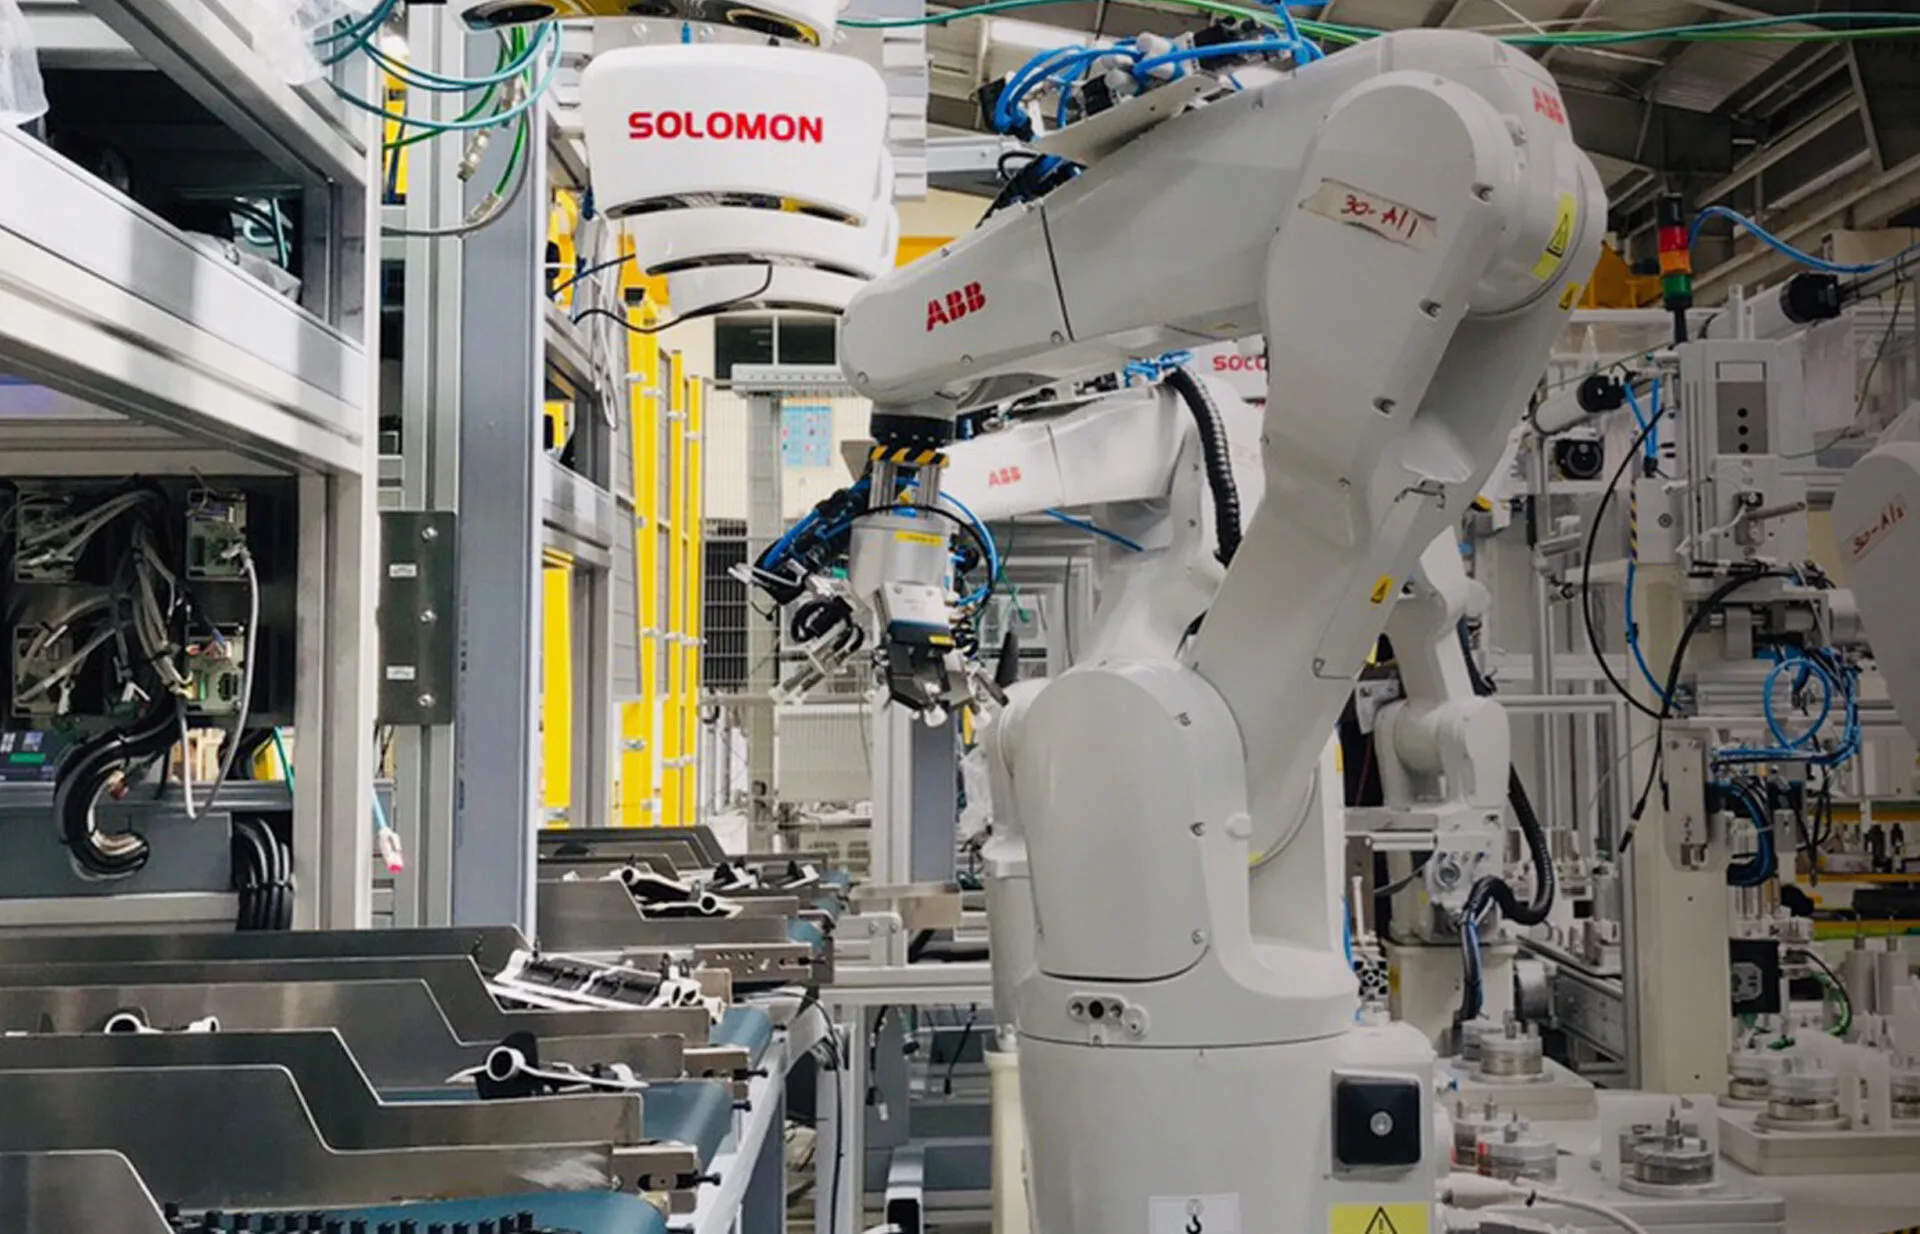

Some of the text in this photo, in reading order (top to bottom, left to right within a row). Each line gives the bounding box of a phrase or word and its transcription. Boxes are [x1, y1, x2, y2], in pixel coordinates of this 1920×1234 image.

[1532, 87, 1565, 126] ABB
[628, 111, 823, 144] SOLOMON
[926, 281, 986, 332] ABB
[987, 466, 1022, 487] ABB
